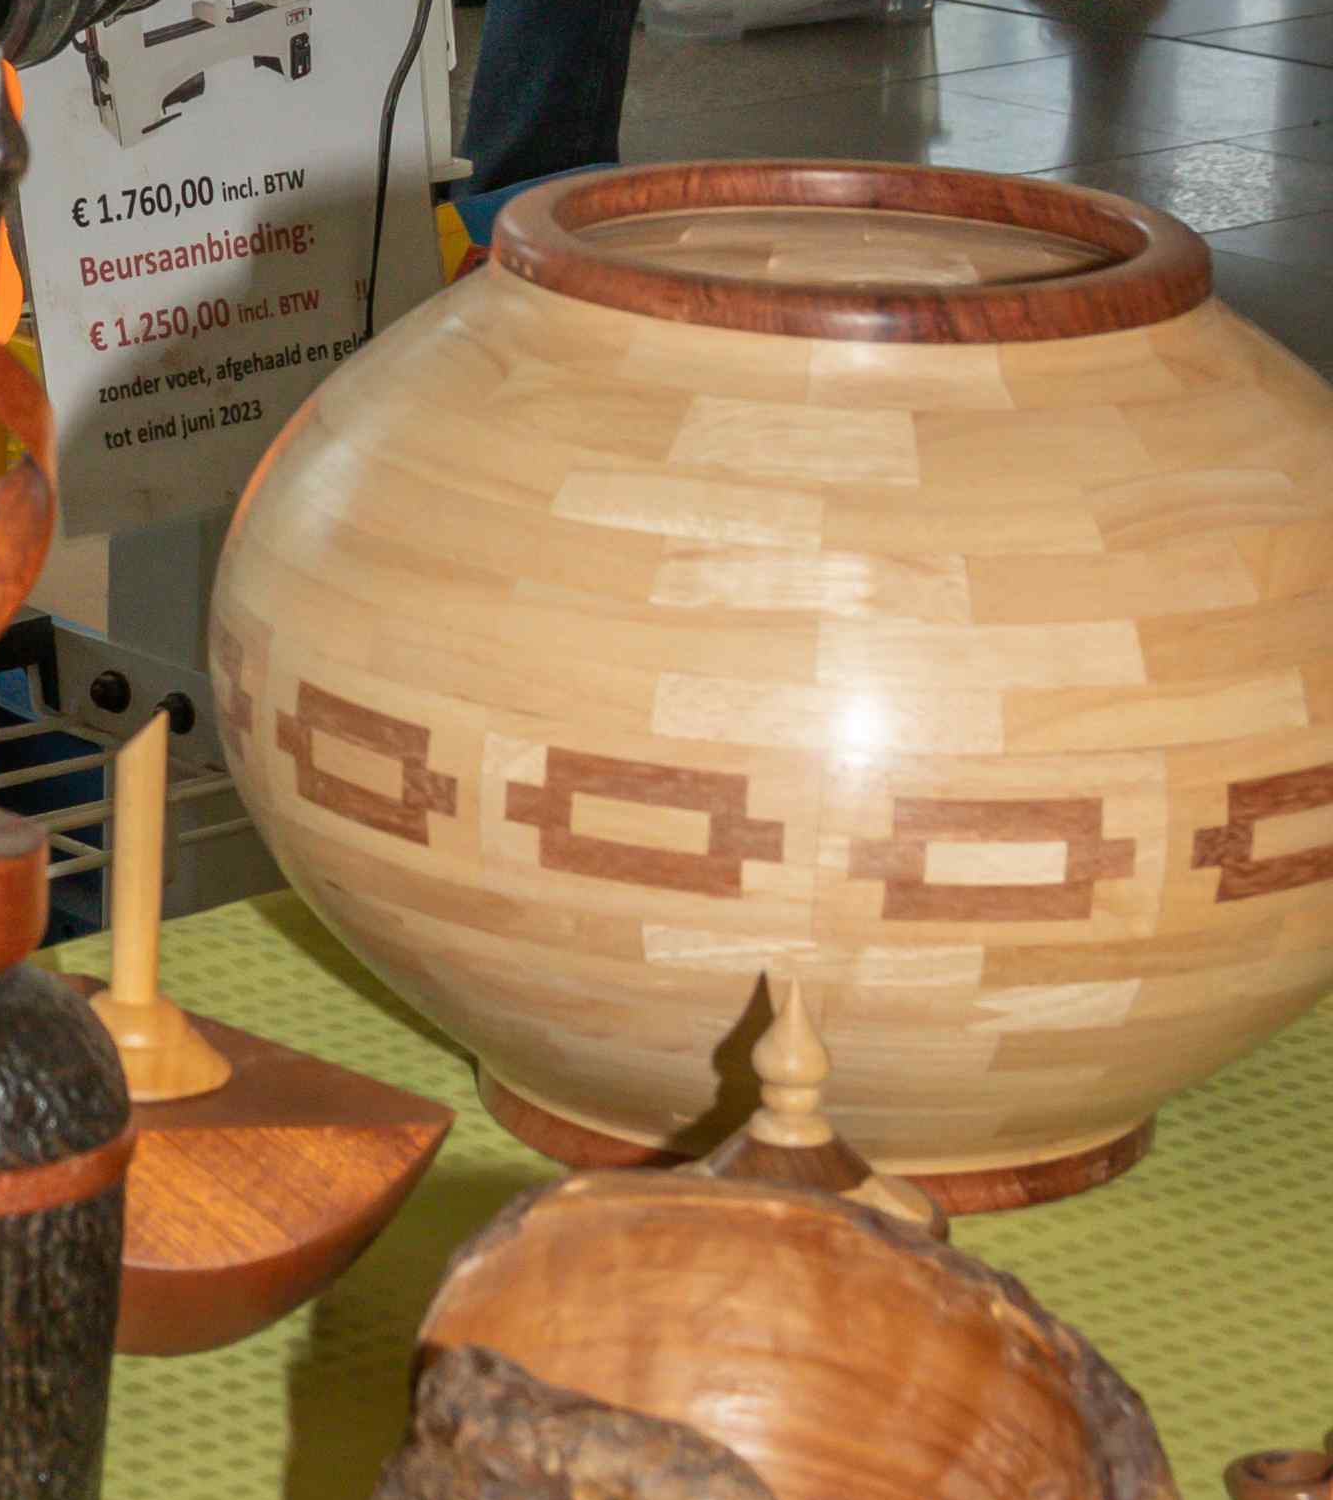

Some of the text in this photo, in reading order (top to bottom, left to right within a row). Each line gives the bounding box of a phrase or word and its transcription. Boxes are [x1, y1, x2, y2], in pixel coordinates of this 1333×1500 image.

[71, 168, 306, 228] € 1.760,00 incl. BTW
[79, 220, 317, 287] Beursaanbieding:
[88, 320, 109, 352] €
[114, 297, 231, 348] 1.250,00
[237, 298, 275, 324] incl.
[278, 288, 320, 316] BTW
[98, 373, 162, 404] zonder
[164, 364, 213, 390] voet,
[215, 343, 302, 382] afgehaald
[306, 342, 329, 362] en
[104, 398, 263, 450] tot eind juni 2023
